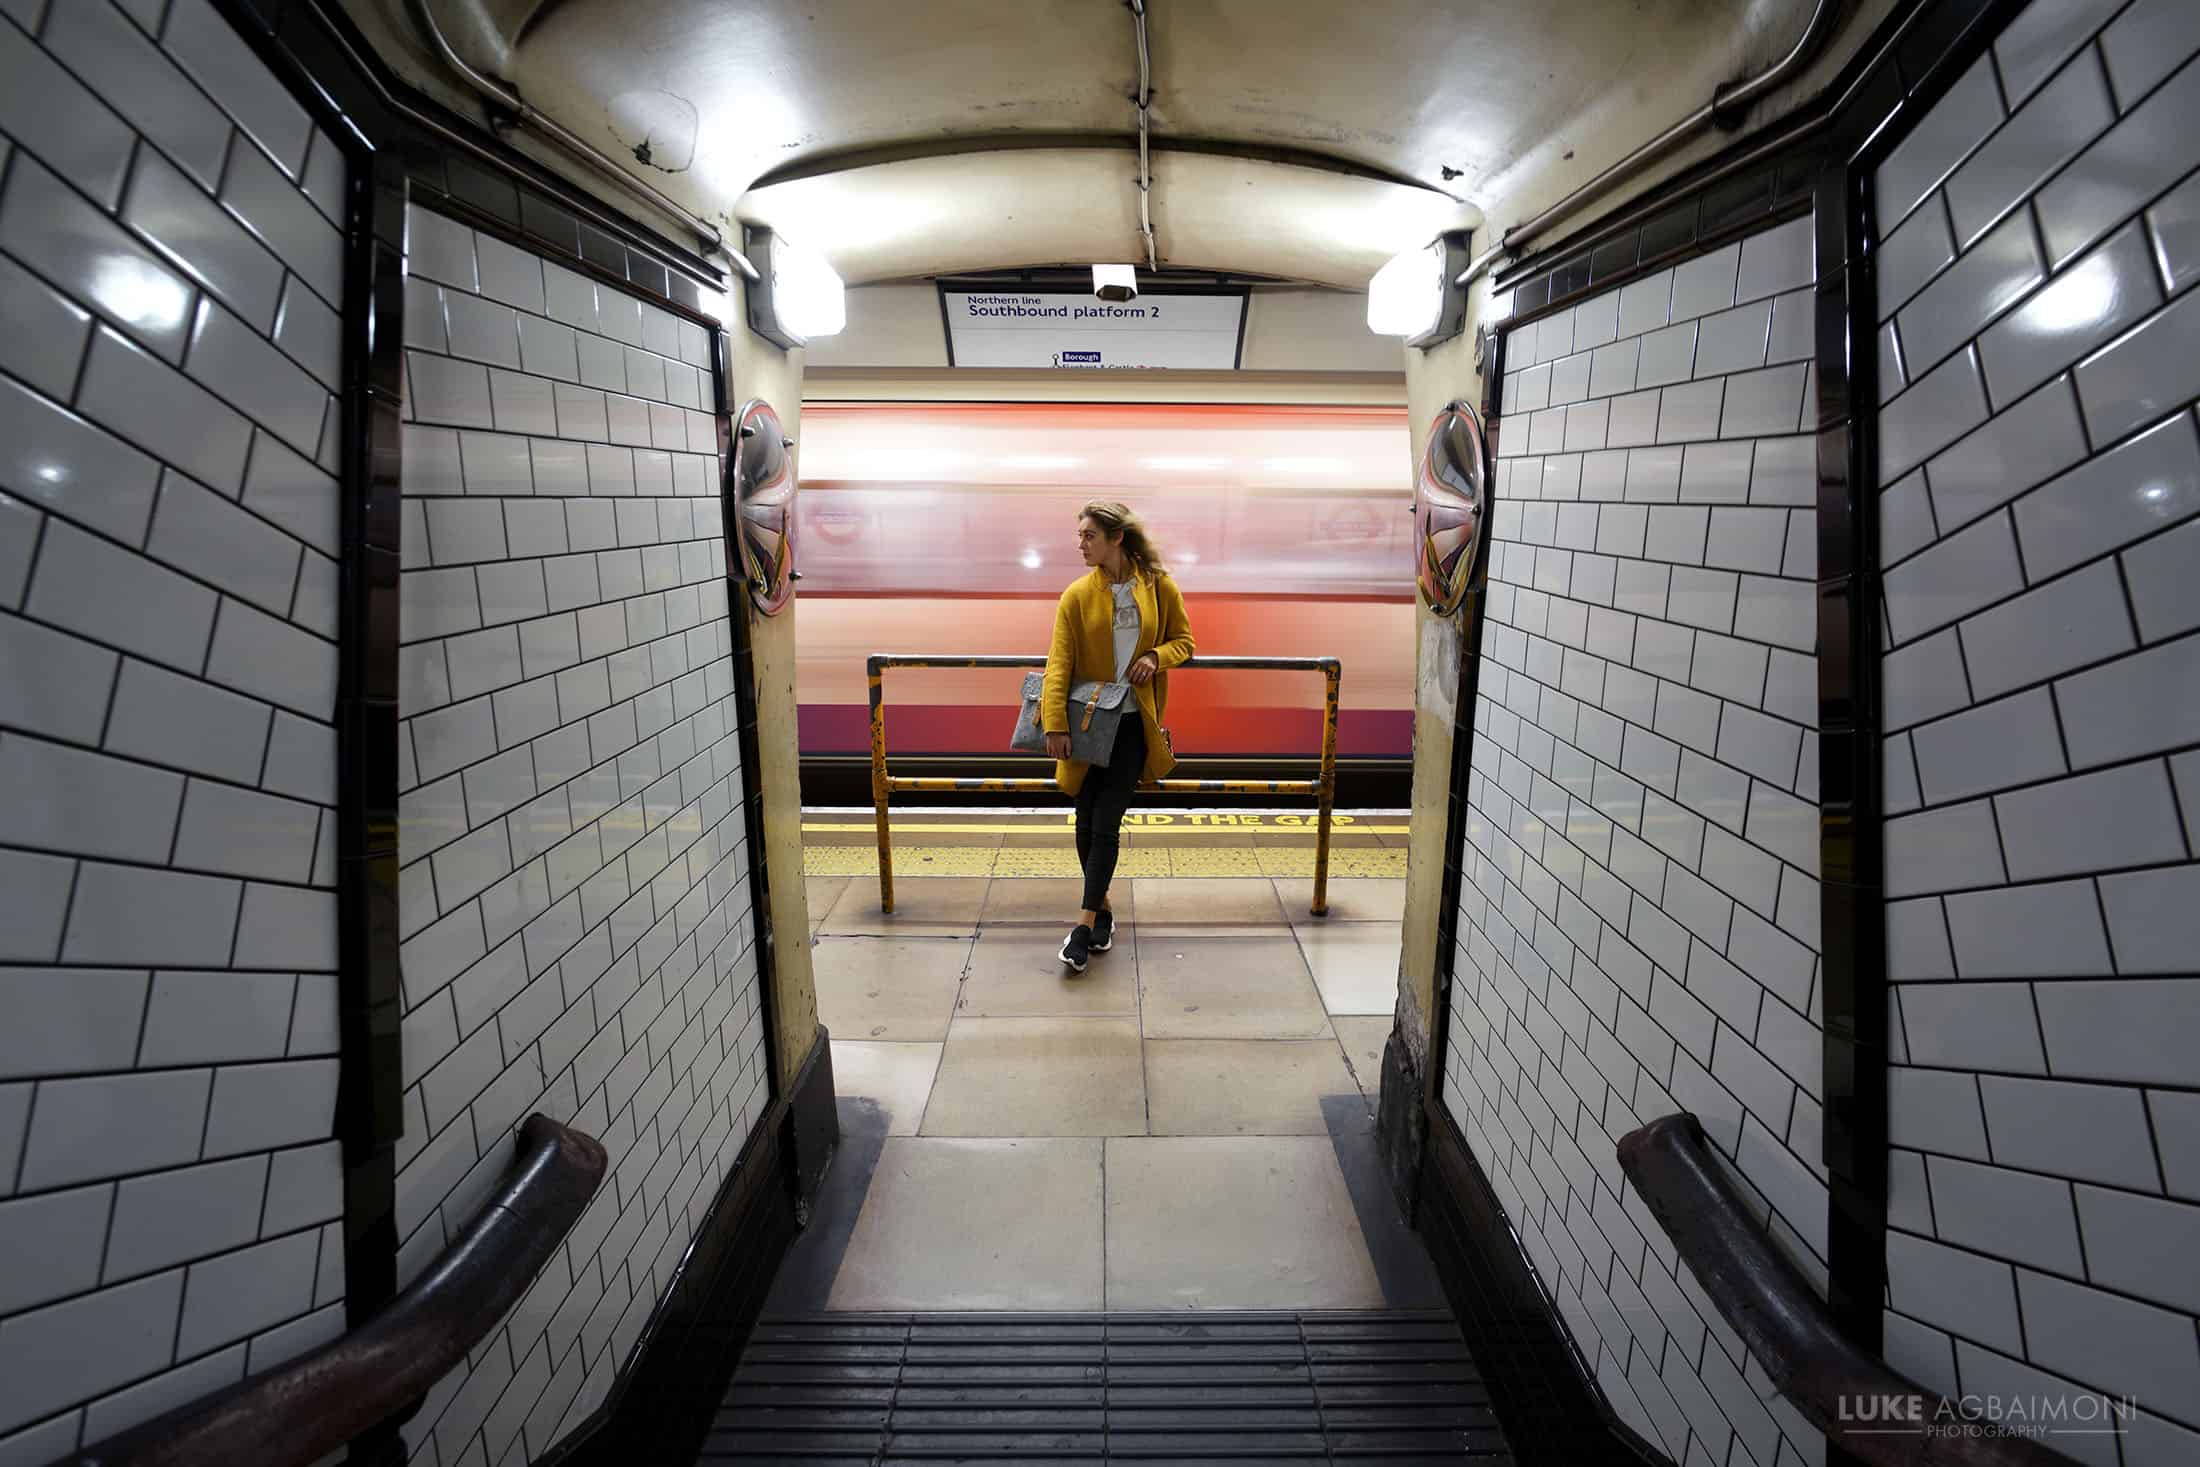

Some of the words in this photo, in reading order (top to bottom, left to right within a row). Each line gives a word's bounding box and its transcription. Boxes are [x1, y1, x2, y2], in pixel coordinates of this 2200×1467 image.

[968, 296, 1018, 304] Northern
[1022, 296, 1041, 304] line
[969, 305, 1067, 317] Southbound
[1074, 306, 1145, 319] platform
[1151, 307, 1160, 317] 2
[1065, 353, 1099, 362] Borough
[1183, 815, 1263, 825] THE
